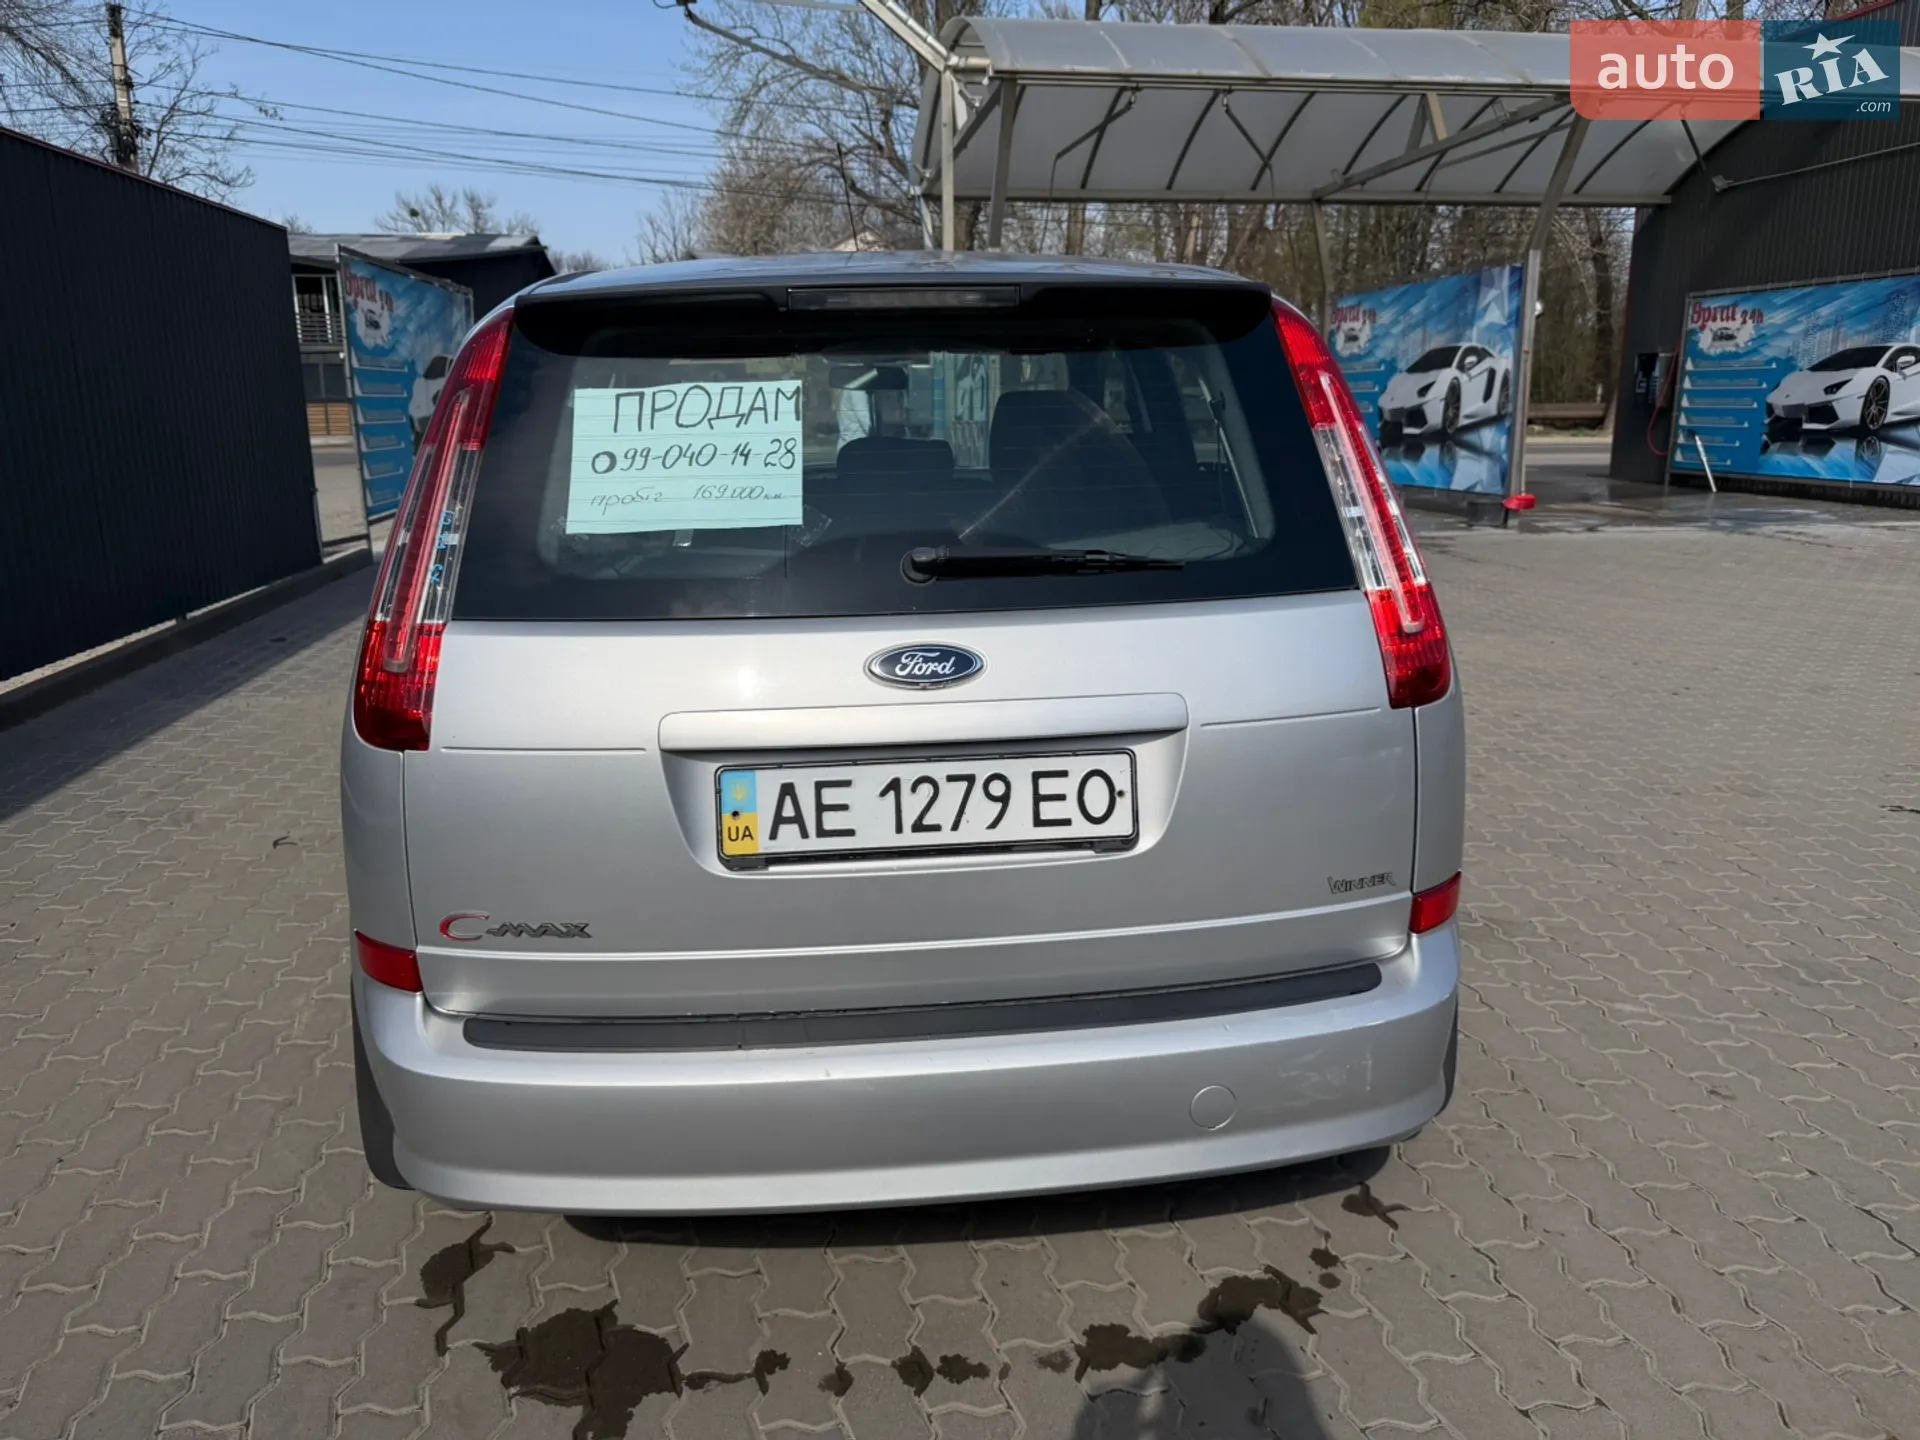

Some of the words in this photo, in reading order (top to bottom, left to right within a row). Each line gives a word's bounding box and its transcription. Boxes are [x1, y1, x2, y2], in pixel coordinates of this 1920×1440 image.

[613, 384, 801, 433] ПРОДАМ
[895, 651, 955, 676] Ford
[768, 779, 856, 841] AE
[878, 772, 1012, 834] 1279
[1031, 769, 1117, 826] EO
[727, 826, 755, 842] UA
